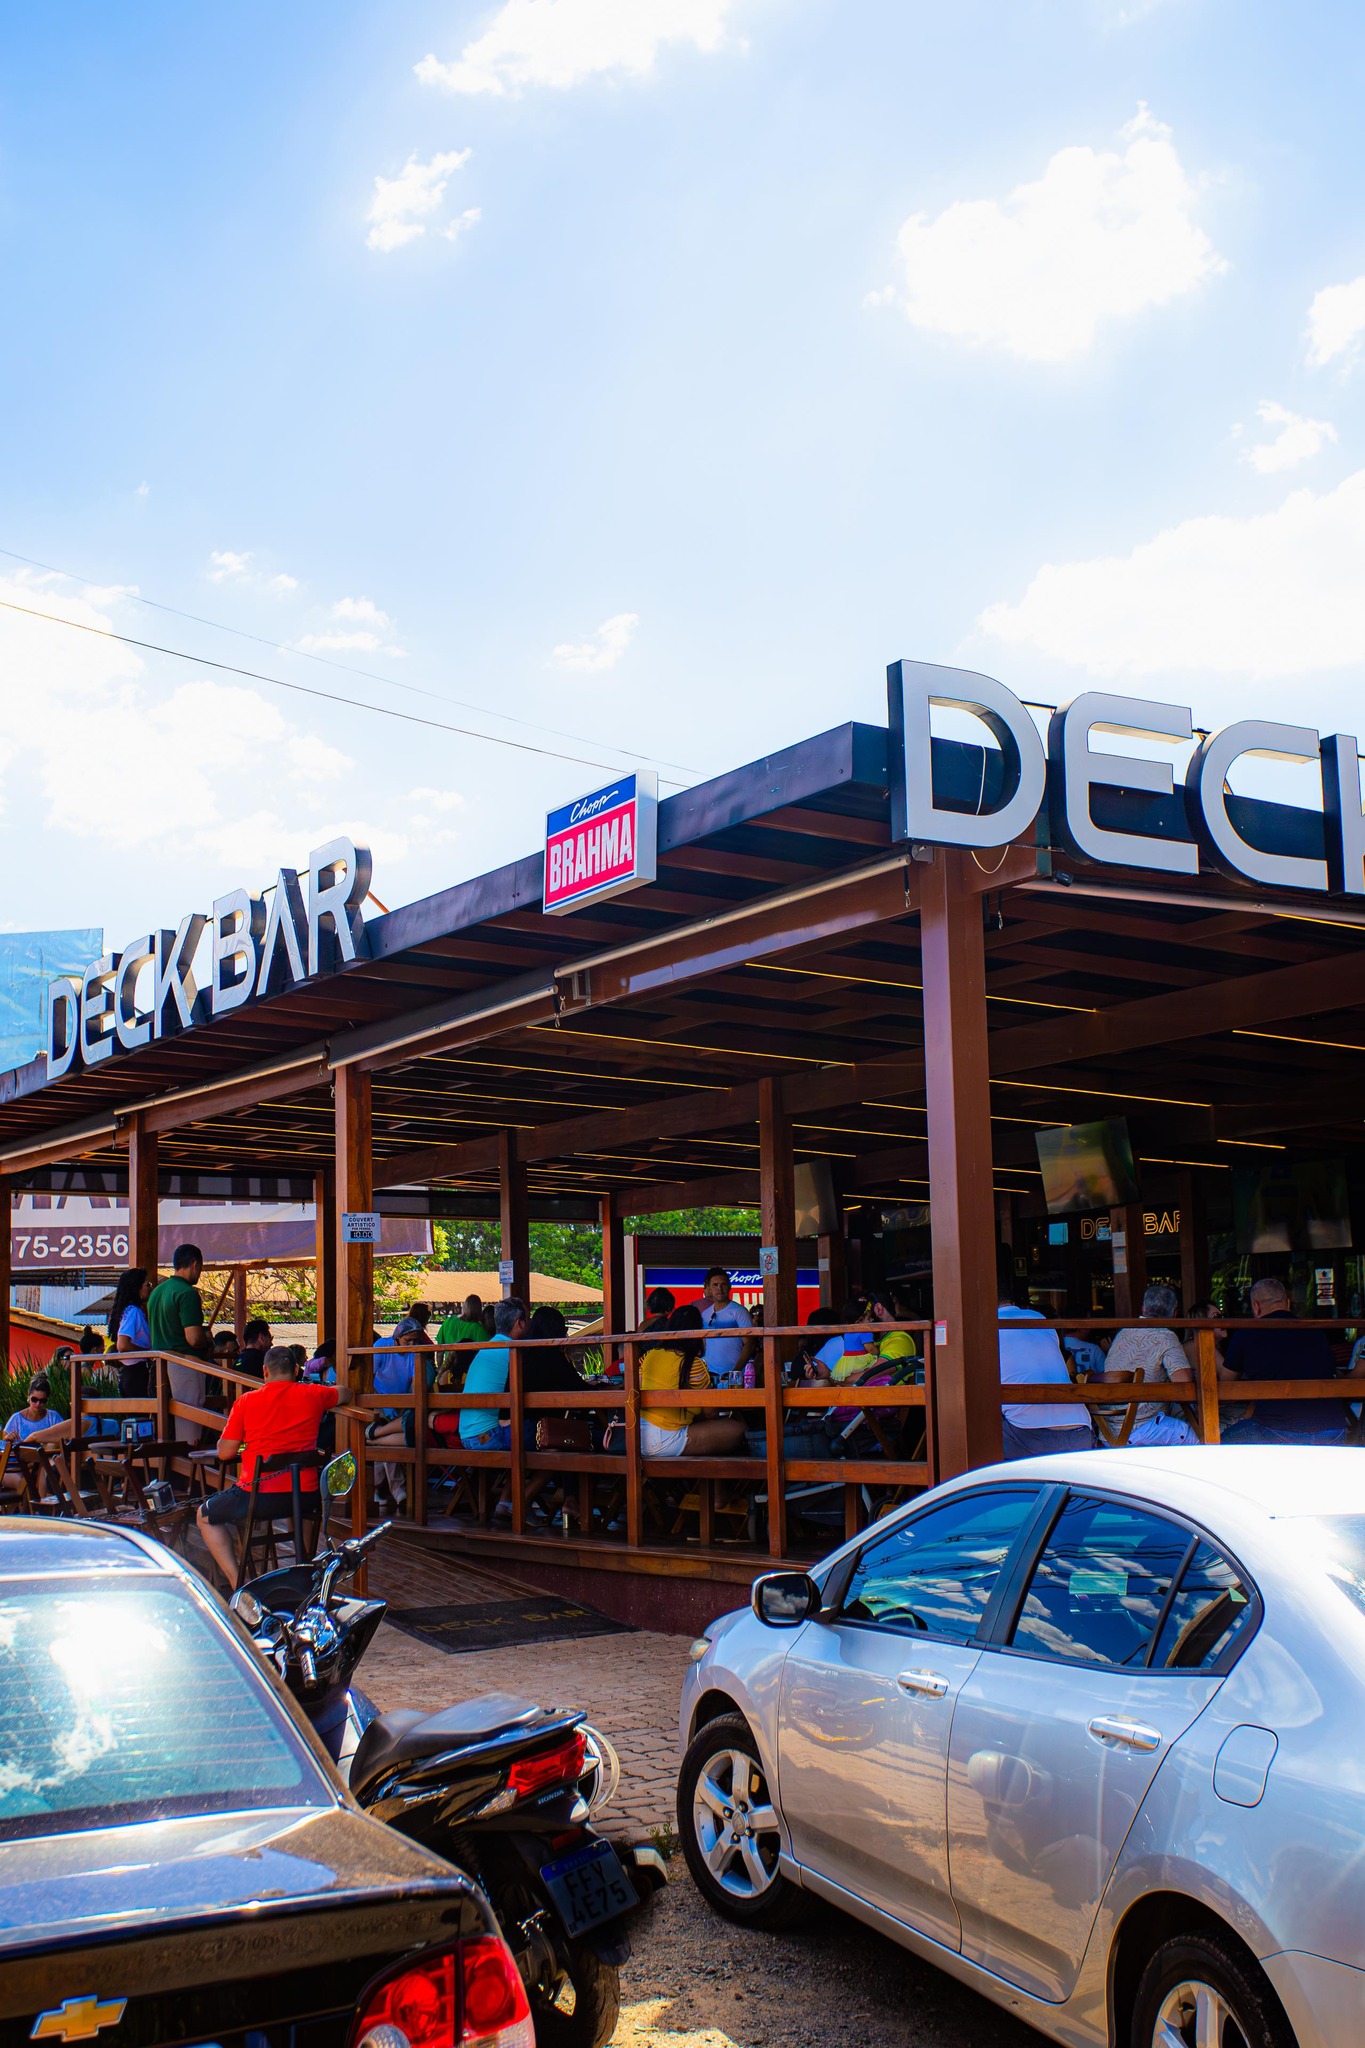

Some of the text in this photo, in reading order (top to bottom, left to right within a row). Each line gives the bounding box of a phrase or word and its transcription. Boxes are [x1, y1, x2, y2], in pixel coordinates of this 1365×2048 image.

[570, 790, 619, 823] Chopp
[549, 812, 633, 893] BRAHMA
[47, 836, 368, 1080] DECK BAR
[12, 1233, 129, 1259] 75-2356
[416, 1608, 592, 1633] DECK BAR
[537, 1788, 565, 1805] HONDA
[562, 1860, 606, 1898] FFY
[570, 1879, 627, 1924] 4E75
